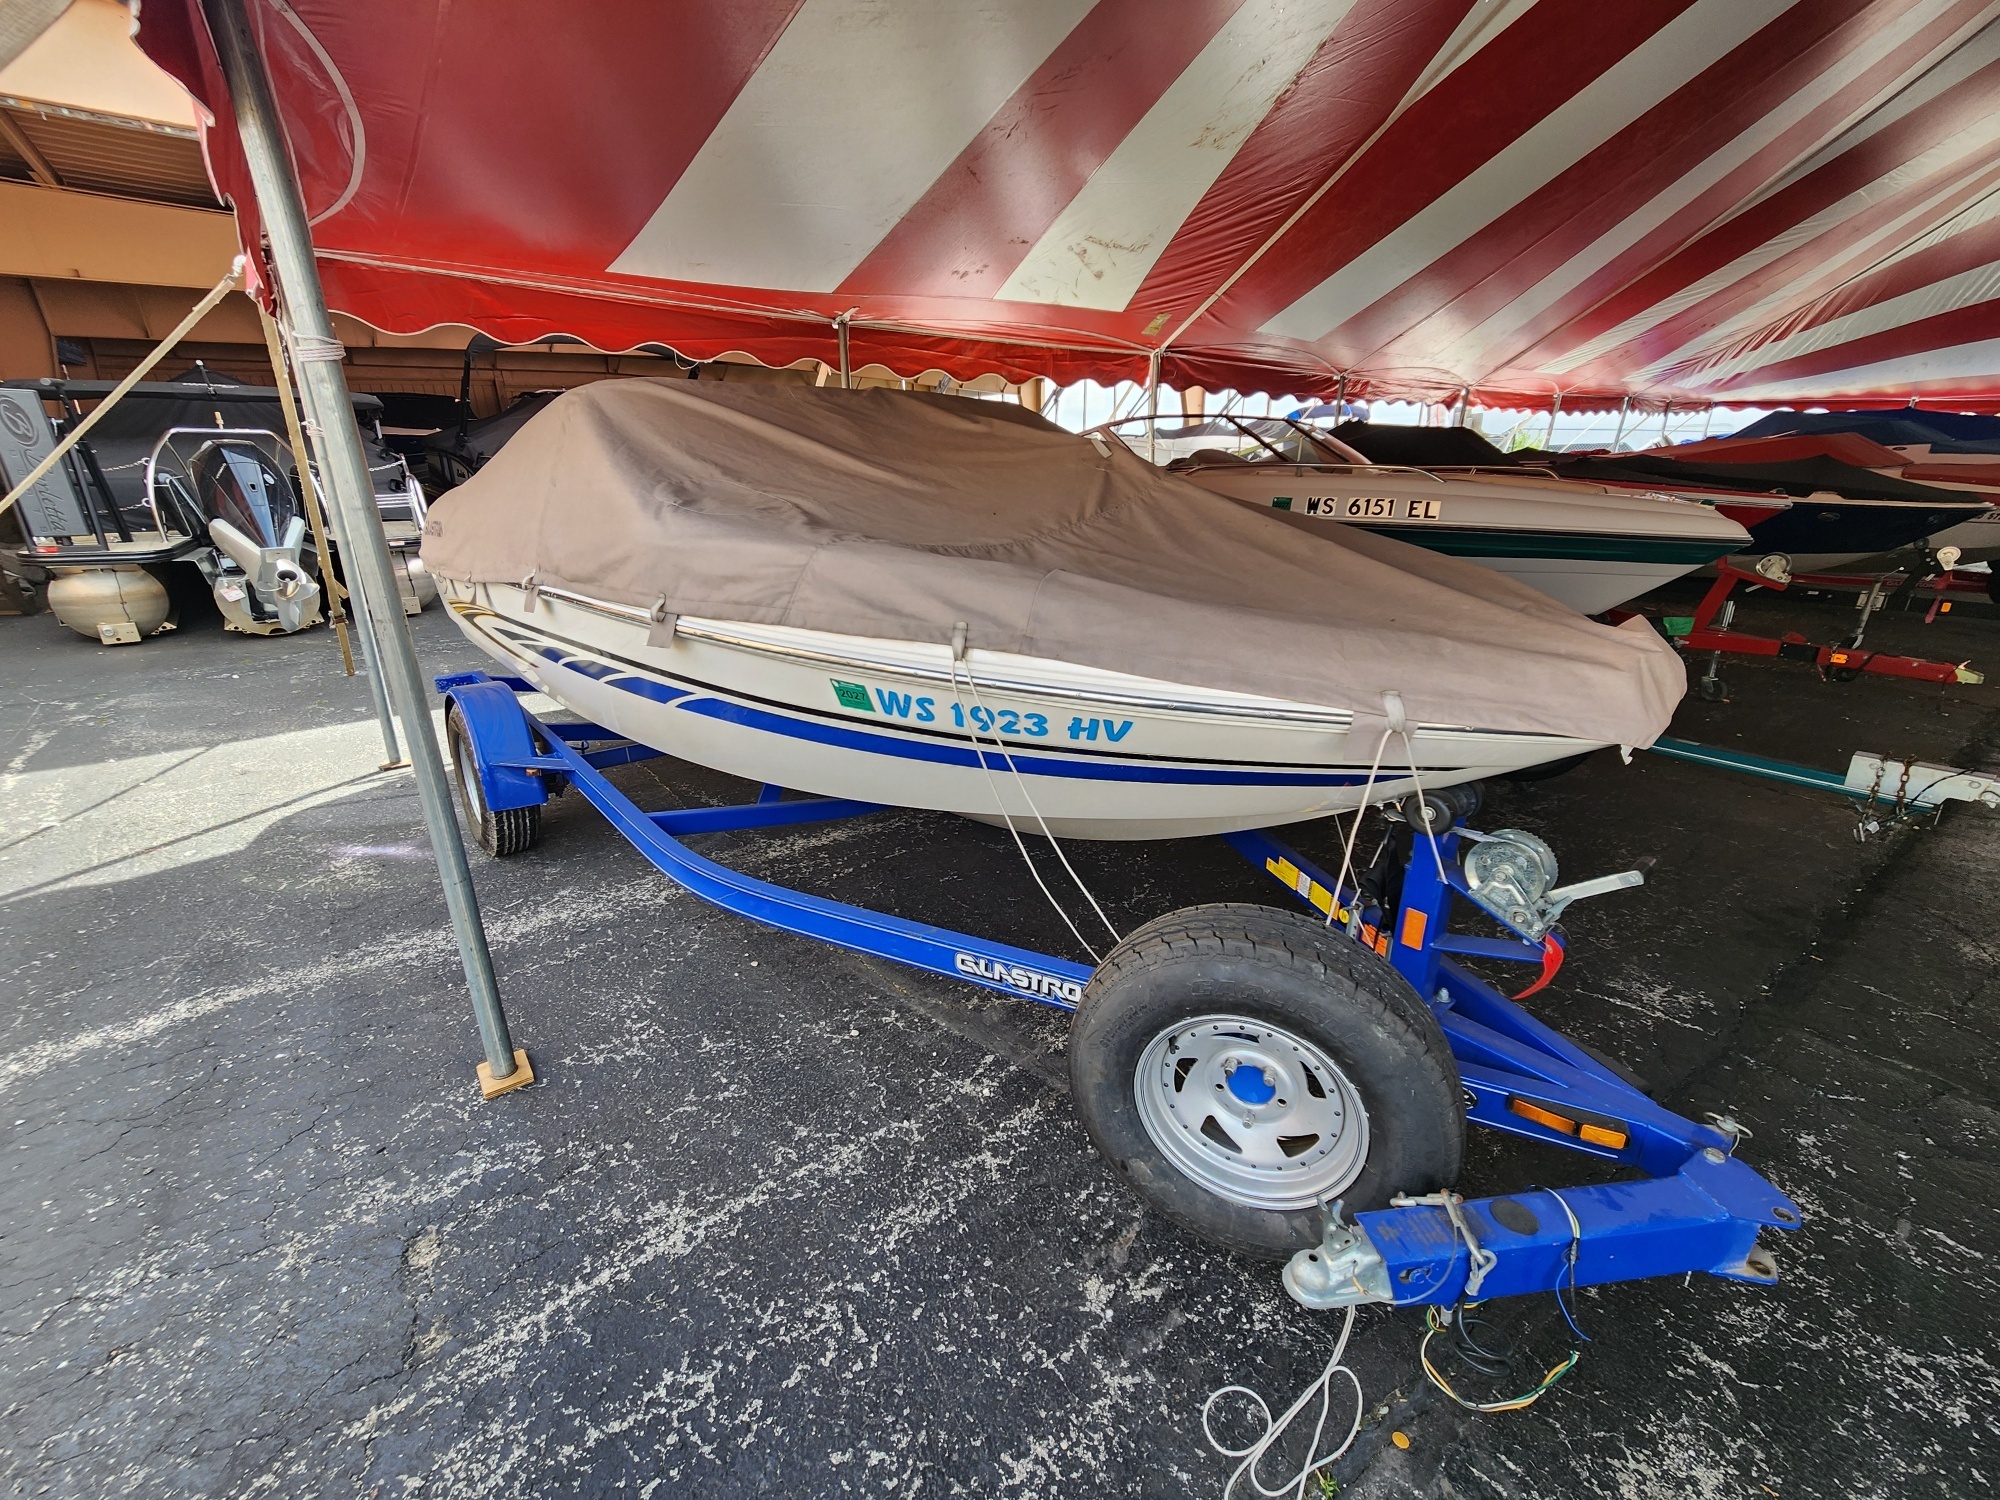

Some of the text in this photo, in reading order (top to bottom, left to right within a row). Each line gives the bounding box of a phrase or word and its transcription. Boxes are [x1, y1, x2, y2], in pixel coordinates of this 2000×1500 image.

[24, 449, 68, 532] Brletta
[1306, 497, 1438, 519] WS 6151 EL
[839, 688, 866, 701] 2027
[875, 687, 1134, 743] WS 1923 HV
[955, 952, 1086, 1003] GLASTRO
[1191, 979, 1370, 1050] CARLISLE
